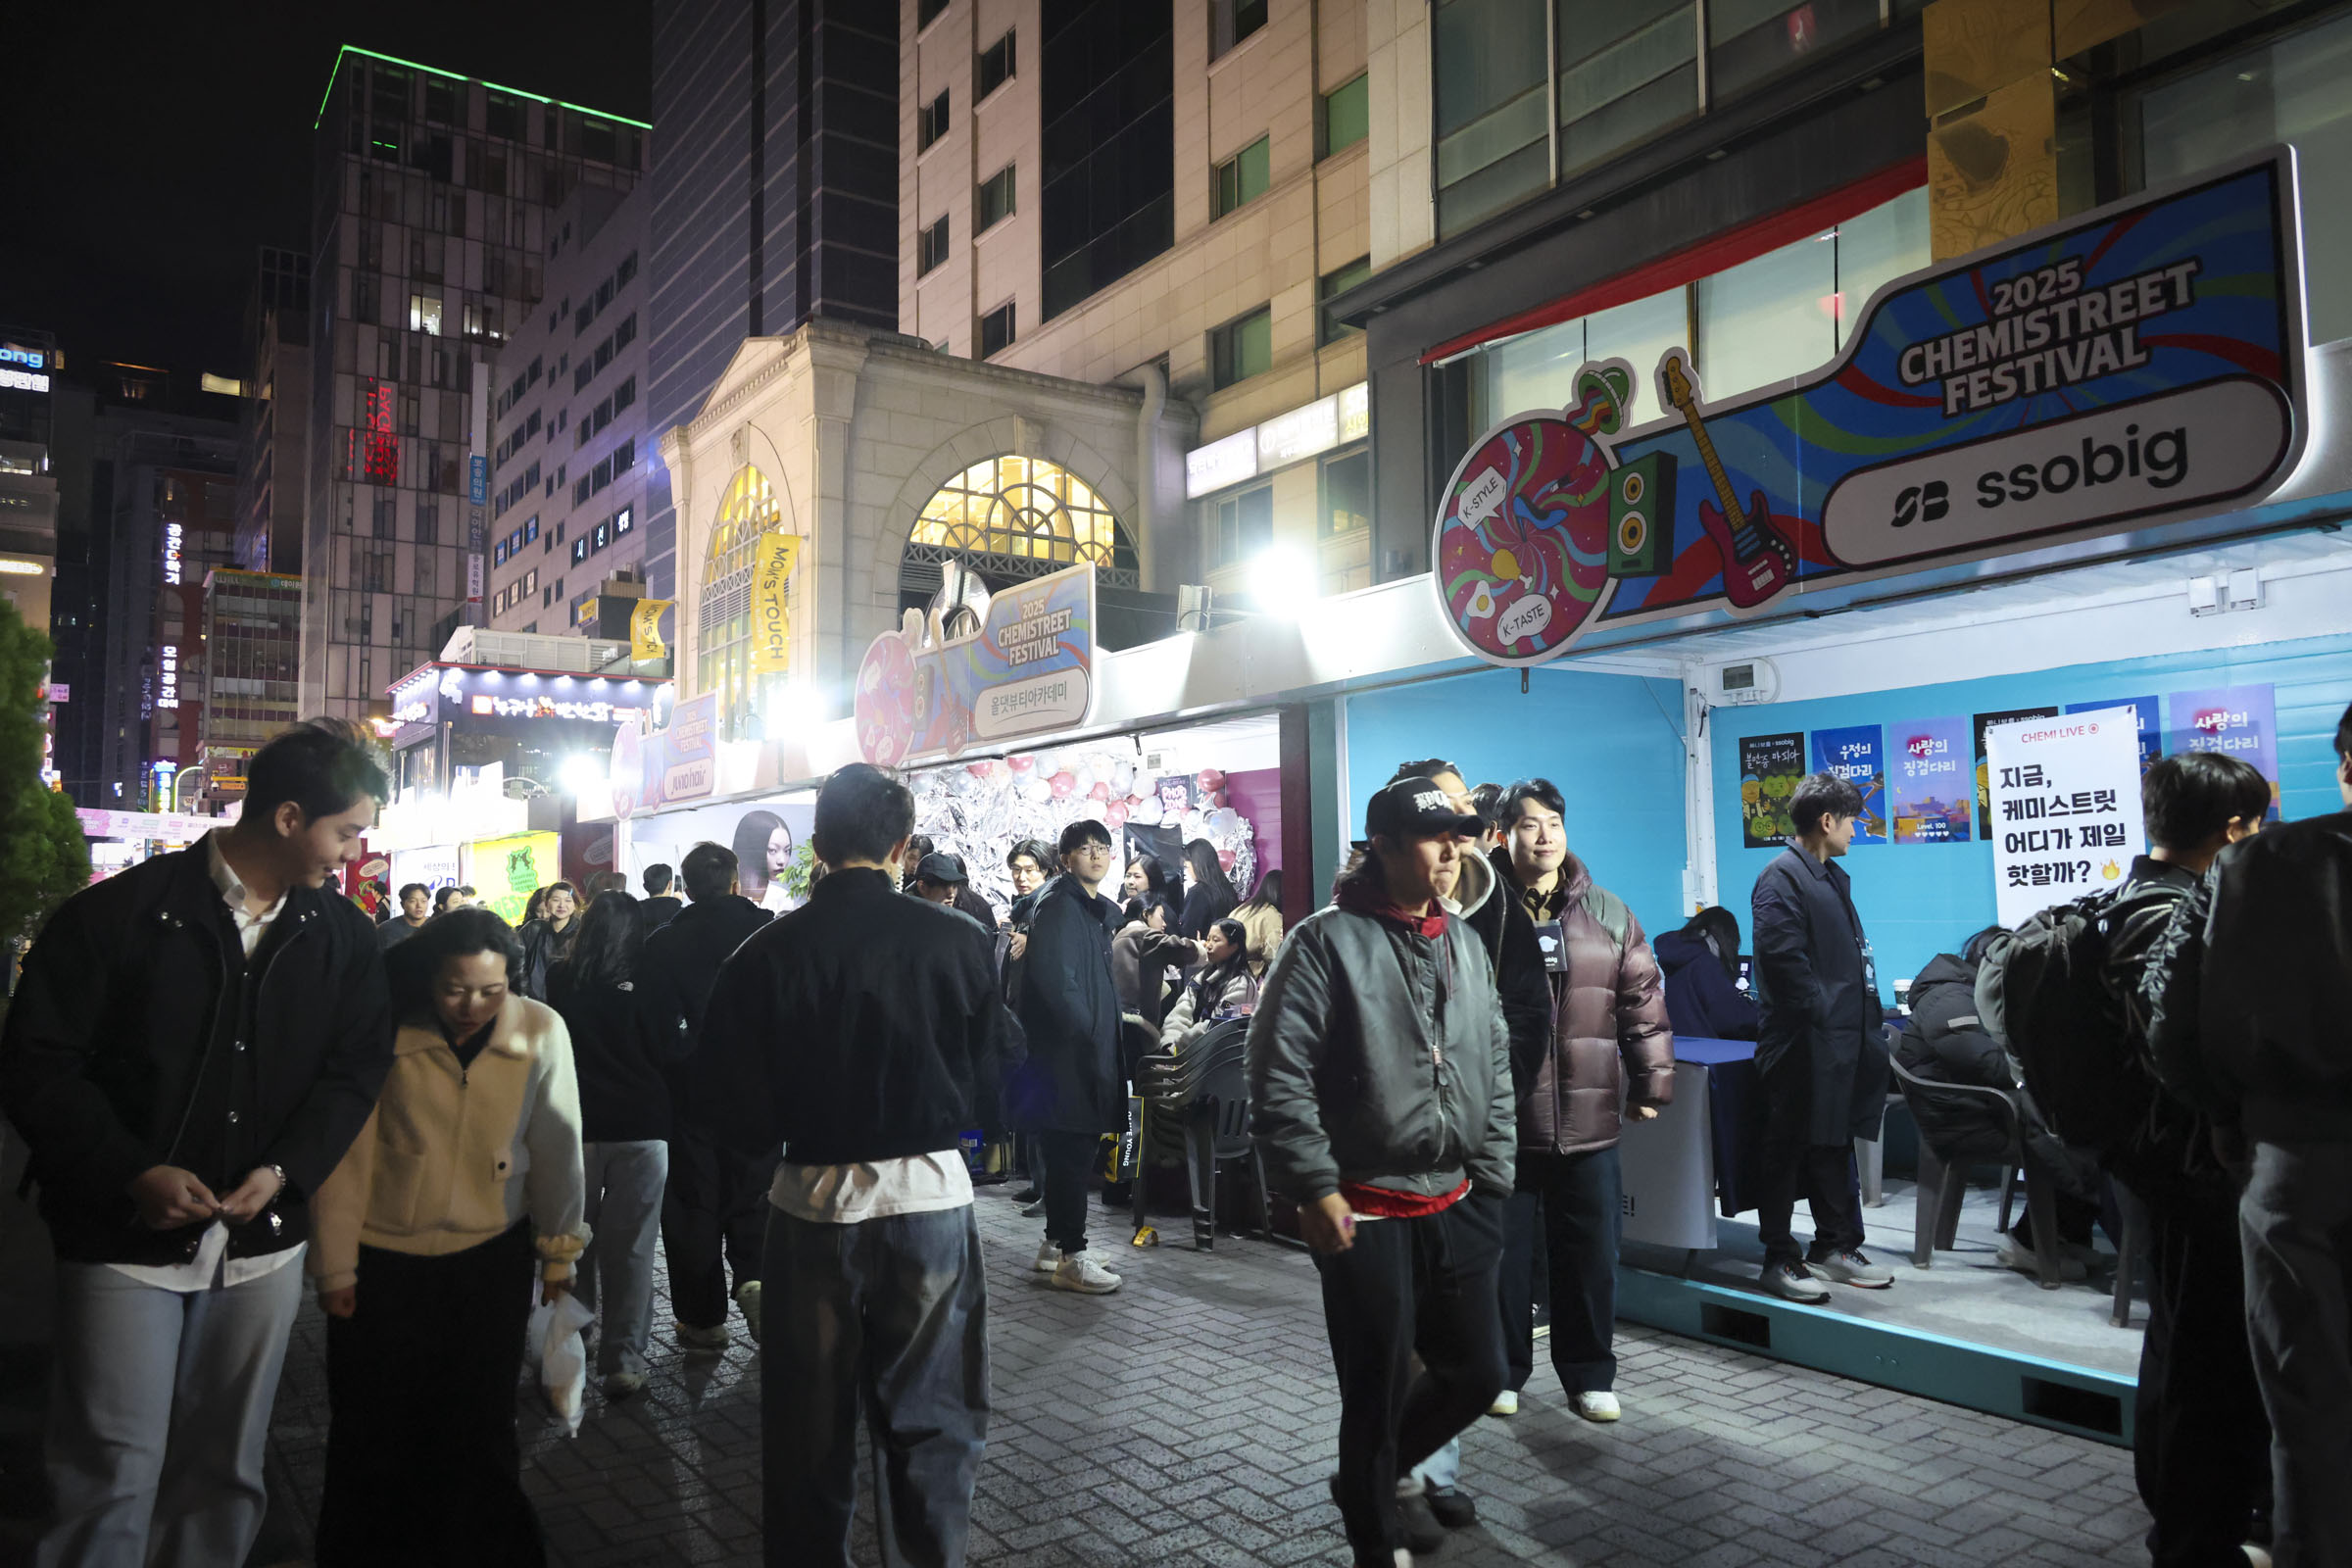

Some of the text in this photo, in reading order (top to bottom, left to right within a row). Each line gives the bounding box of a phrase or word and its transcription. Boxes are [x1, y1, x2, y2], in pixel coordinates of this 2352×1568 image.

[1992, 259, 2082, 316] 2025
[1900, 260, 2199, 385] CHEMISTREET
[1944, 325, 2148, 415] FESTIVAL
[1976, 423, 2188, 509] ssobig
[1462, 476, 1499, 519] K-STYLE
[763, 547, 790, 660] MOM'S TOUCH
[1022, 599, 1046, 619] 2025
[998, 609, 1072, 648] CHEMISTREET
[1502, 603, 1546, 637] K-TASTE
[1008, 635, 1059, 666] FESTIVAL
[991, 681, 1067, 716] 올댓뷰티아카데미
[2021, 725, 2085, 744] CHEMI LIVE
[2195, 710, 2248, 731] 사랑의
[1839, 743, 1872, 760] 우정의
[1908, 738, 1948, 757] 사랑의
[2188, 735, 2259, 754] 징검다리
[1903, 760, 1956, 777] 징검다리
[1999, 763, 2052, 789] 지금,
[2002, 789, 2117, 821] 케미스트릿
[2004, 822, 2126, 854] 어디가 제일
[2006, 859, 2091, 888] 핫할까?
[1122, 1138, 1133, 1167] YOUNG
